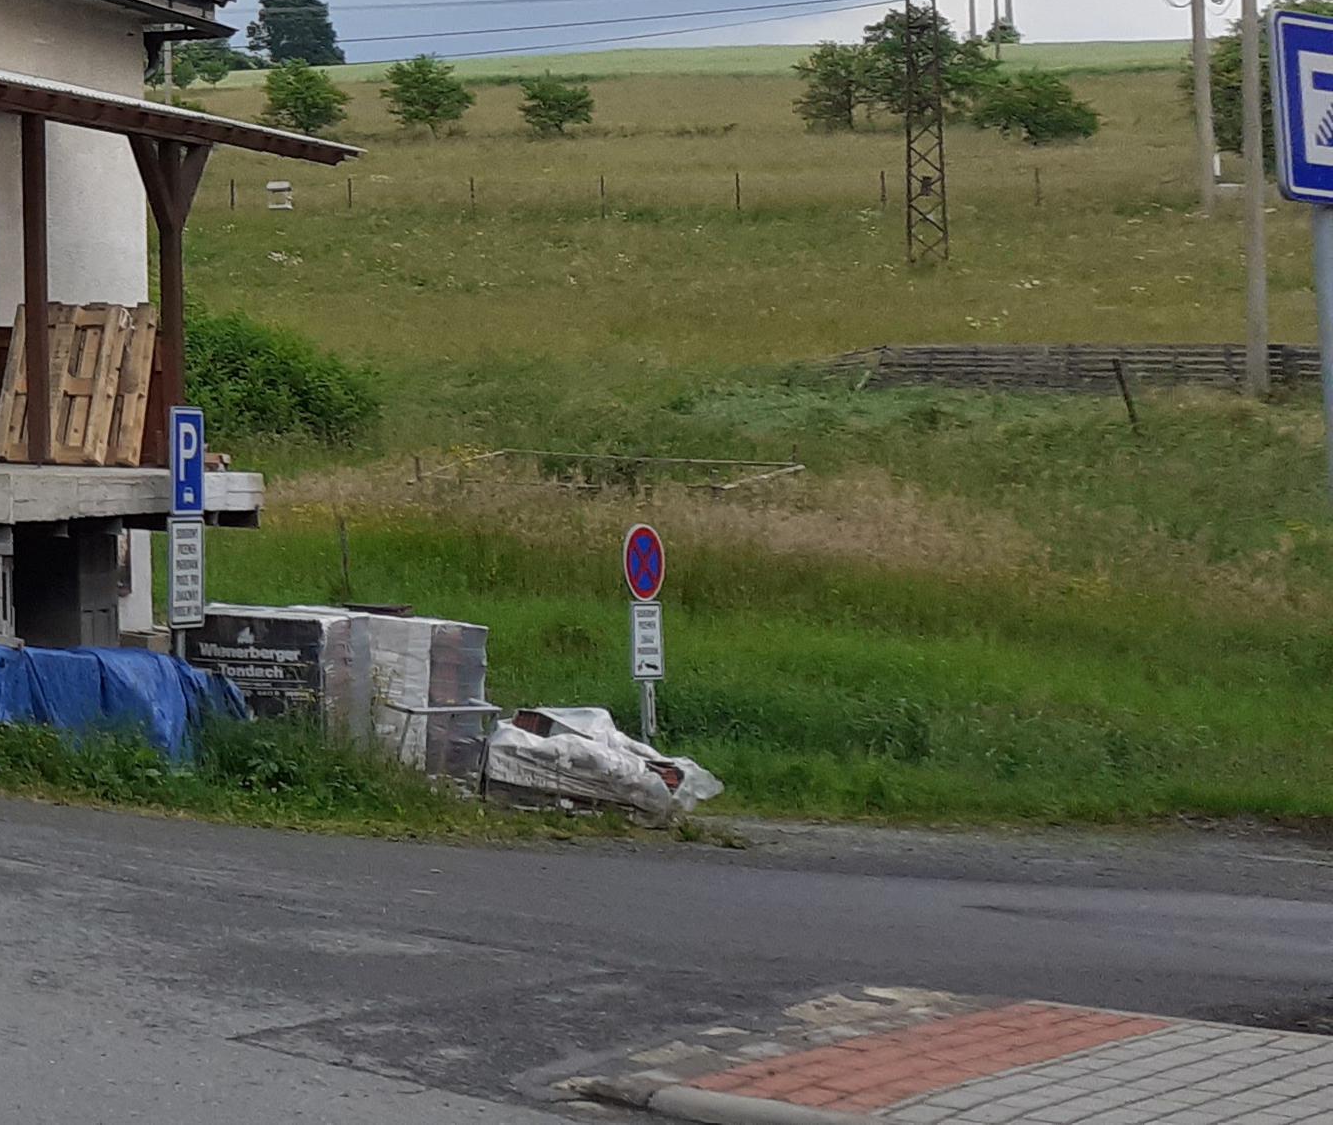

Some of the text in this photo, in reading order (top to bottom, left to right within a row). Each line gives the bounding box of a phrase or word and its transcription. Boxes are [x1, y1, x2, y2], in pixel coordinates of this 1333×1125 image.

[179, 422, 197, 481] P
[198, 642, 301, 663] Wienerberger
[218, 663, 284, 679] Tondach
